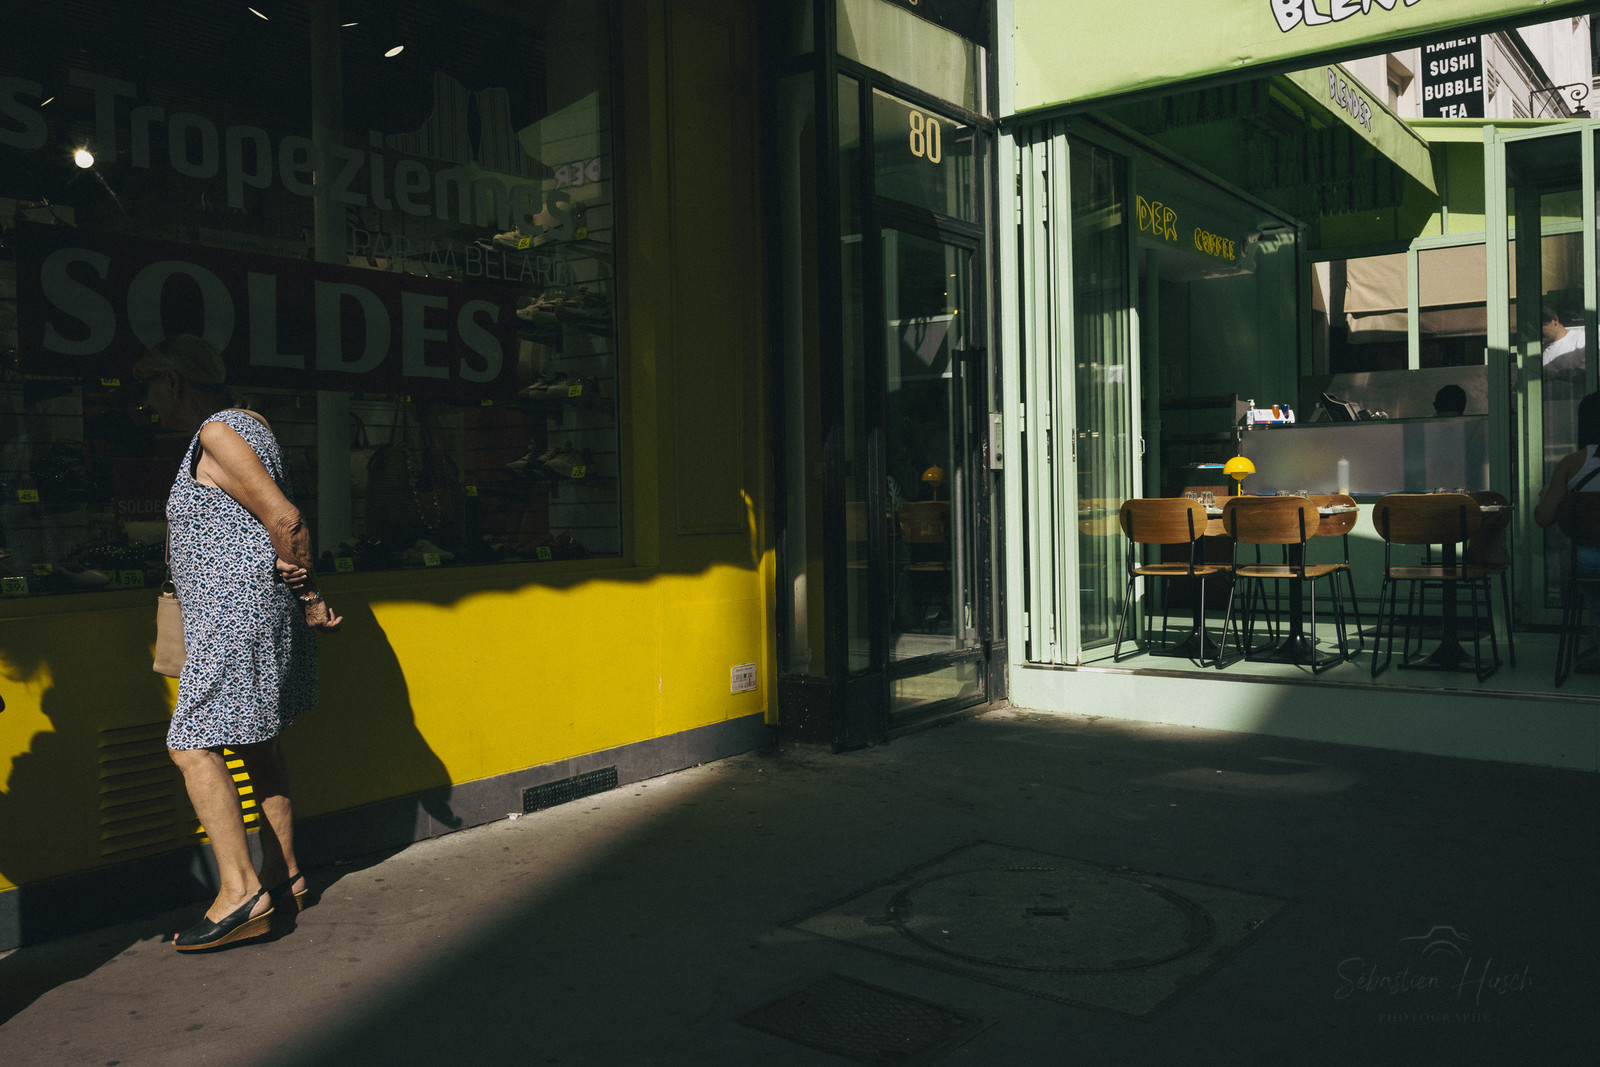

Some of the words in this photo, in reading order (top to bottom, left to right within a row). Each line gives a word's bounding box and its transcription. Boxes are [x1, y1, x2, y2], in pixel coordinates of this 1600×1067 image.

[1429, 52, 1475, 77] SUSHI
[1327, 67, 1372, 133] BLENDER
[1424, 75, 1482, 101] BUBBLE
[1439, 102, 1468, 118] TEA
[69, 69, 575, 239] Tropeziennes
[909, 110, 942, 164] 80
[1194, 227, 1236, 261] COFFEE
[40, 247, 503, 383] SOLDES
